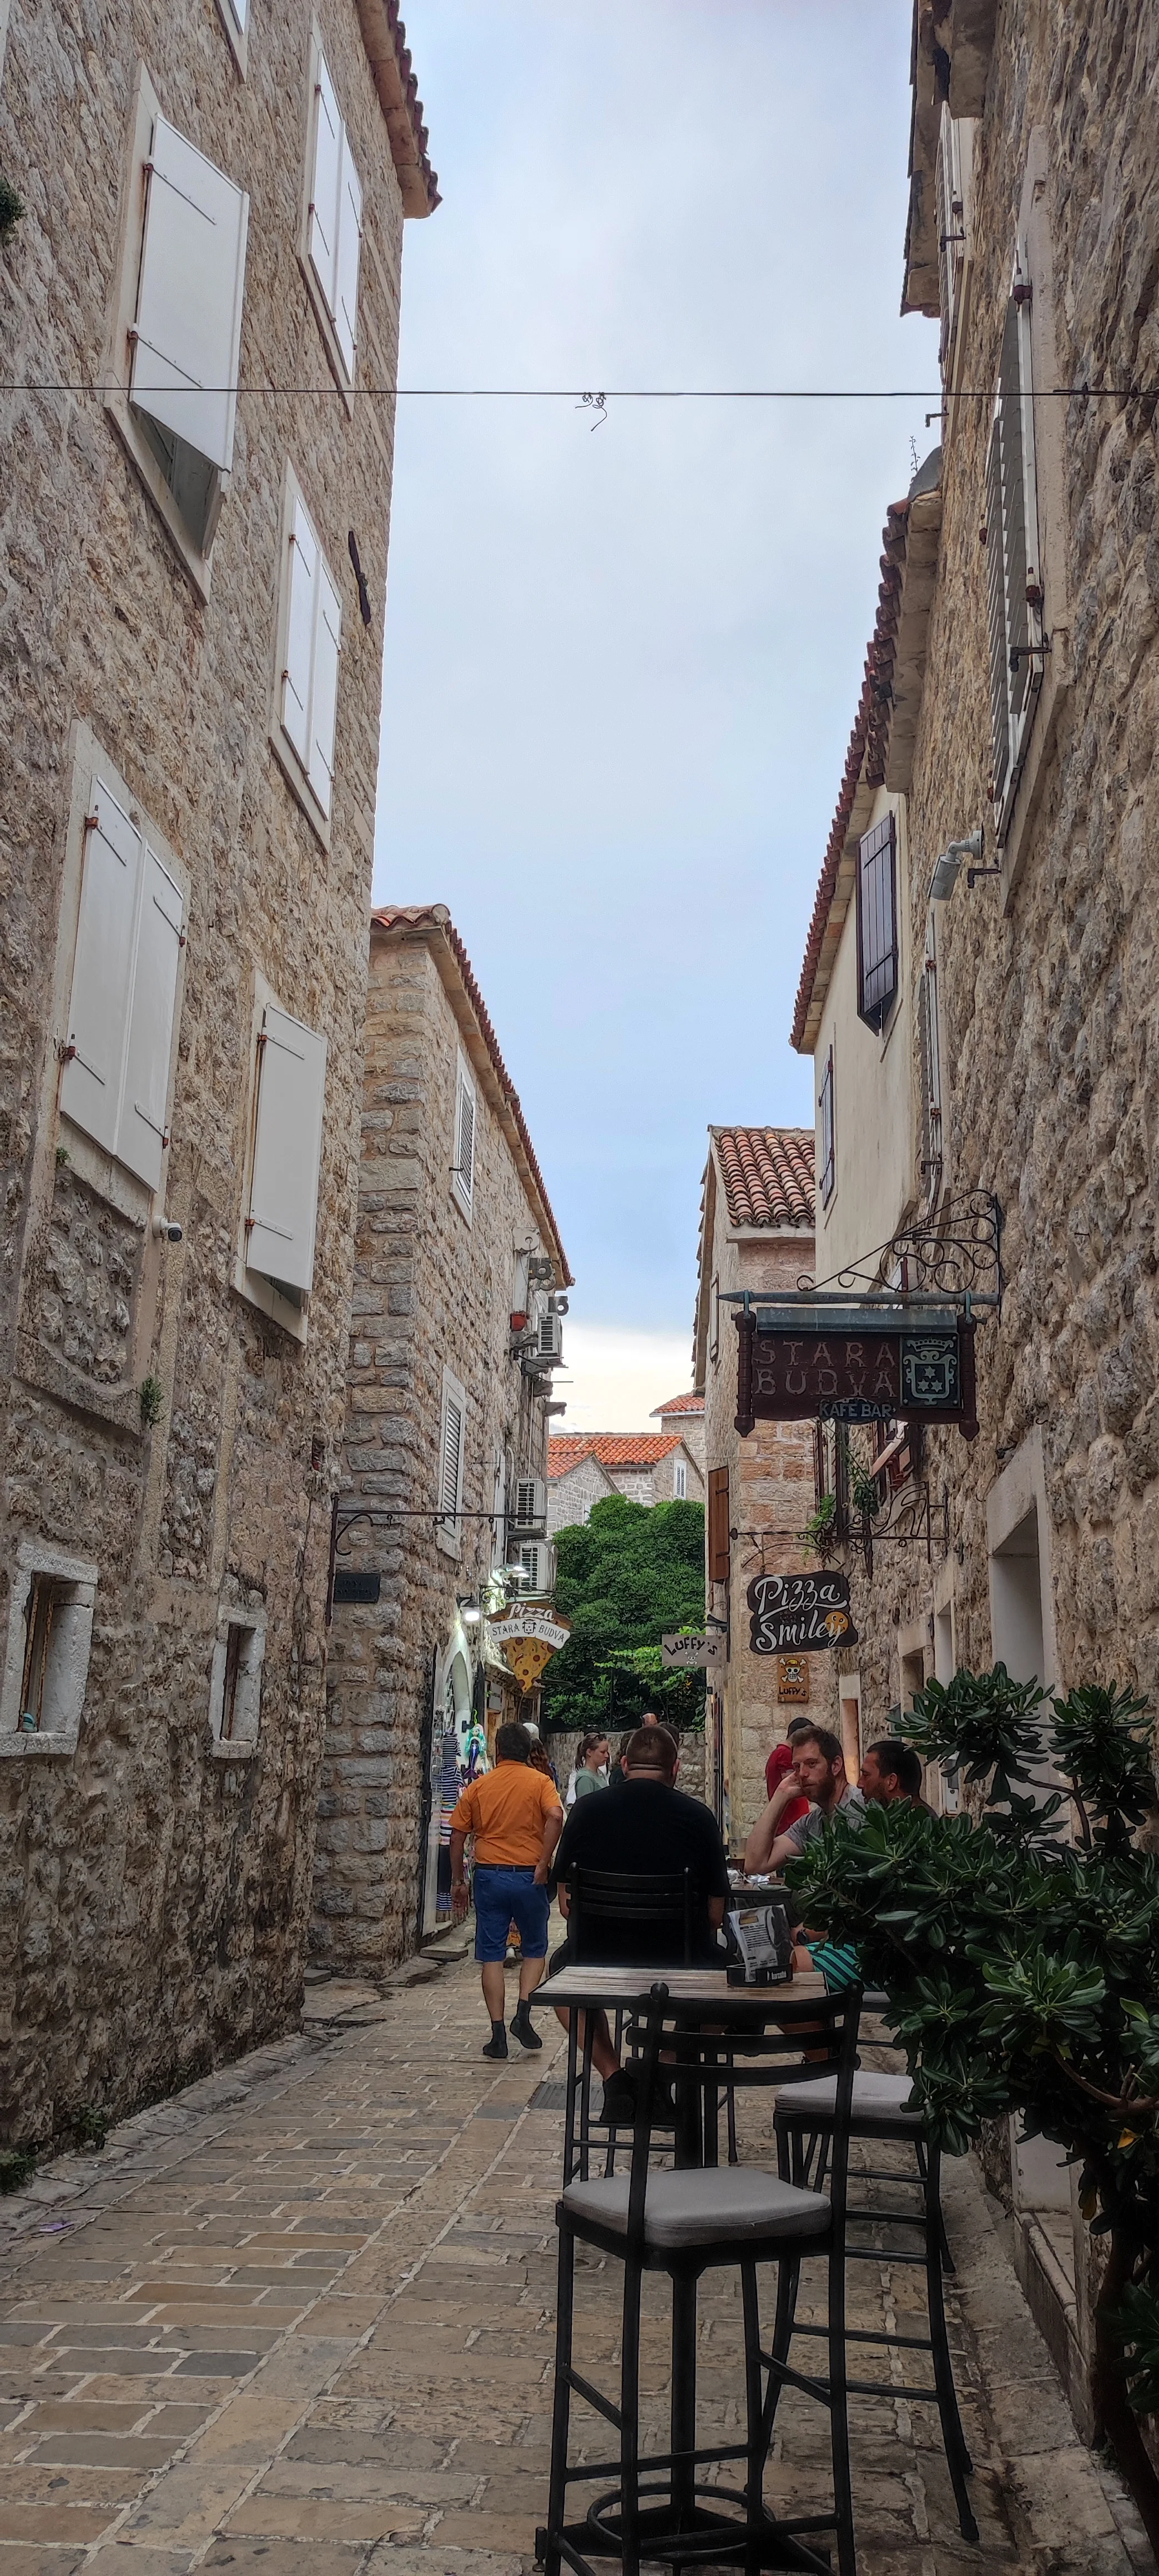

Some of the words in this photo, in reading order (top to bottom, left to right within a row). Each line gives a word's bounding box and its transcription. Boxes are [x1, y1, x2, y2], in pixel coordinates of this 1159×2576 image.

[754, 1340, 897, 1368] STARA
[754, 1368, 897, 1398] BUDVA
[820, 1403, 858, 1417] KAFE
[860, 1403, 892, 1417] BAR
[754, 1576, 840, 1615] Pizza
[507, 1603, 555, 1621] Pizza
[492, 1624, 520, 1636] STARA
[538, 1624, 565, 1642] BUDVA
[755, 1609, 843, 1652] Smiley
